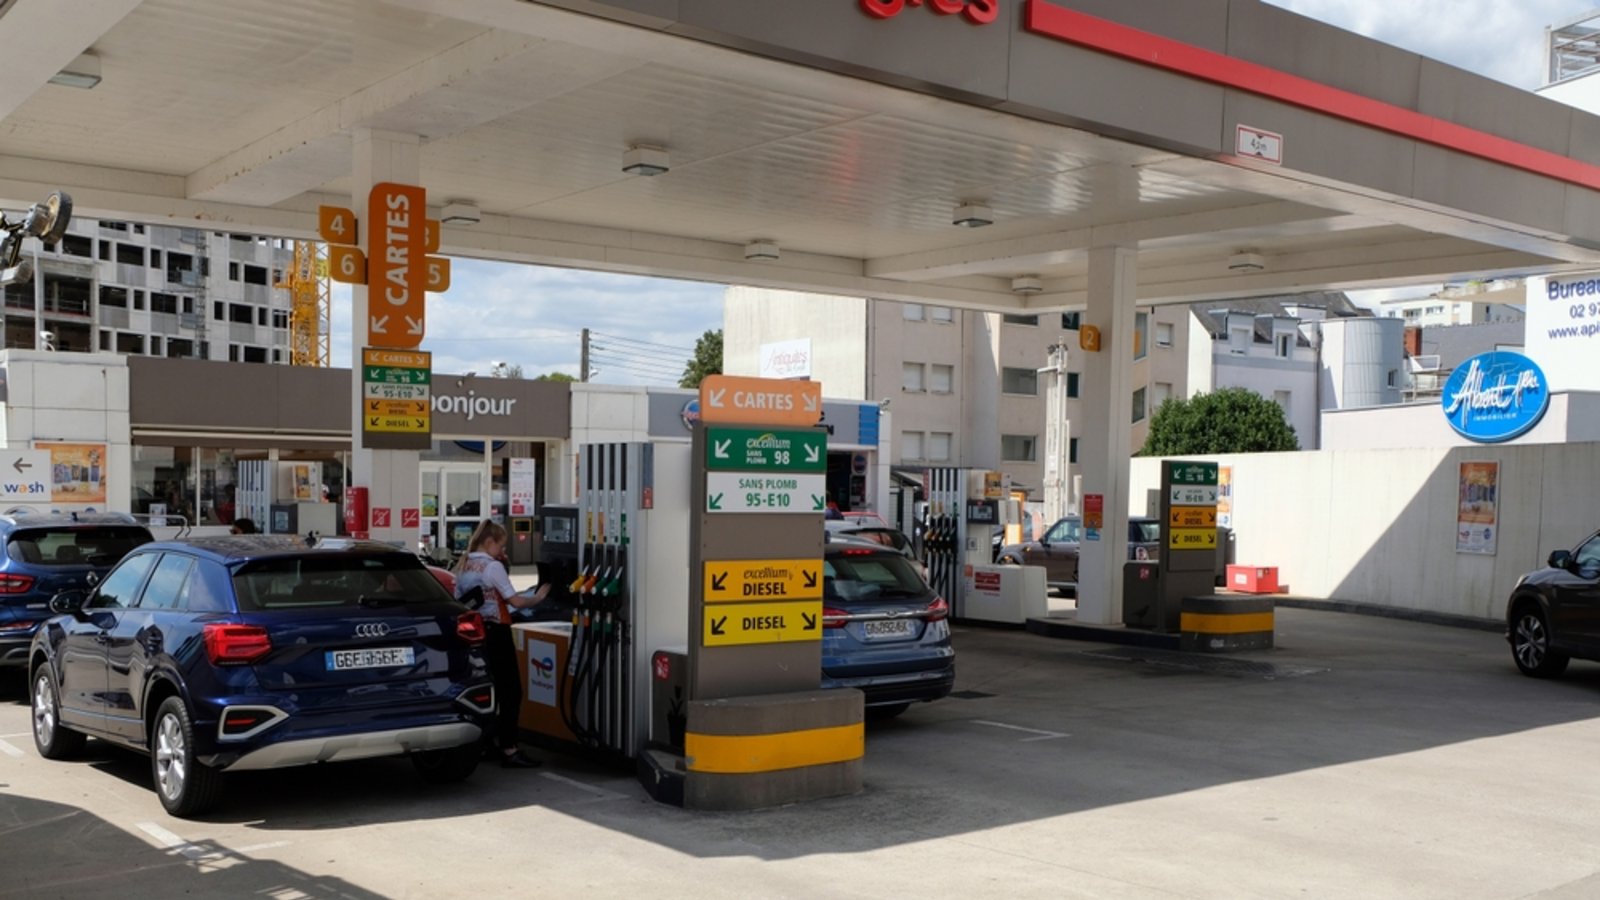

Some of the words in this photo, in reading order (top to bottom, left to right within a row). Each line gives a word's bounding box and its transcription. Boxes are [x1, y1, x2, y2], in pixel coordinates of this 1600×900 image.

[330, 214, 345, 236] 4
[386, 193, 410, 307] CARTES
[341, 253, 356, 276] 6
[428, 263, 441, 285] 5
[1570, 303, 1585, 319] 02
[1086, 329, 1095, 346] 2
[383, 354, 413, 363] CARTES
[384, 390, 413, 399] 95-E10
[733, 391, 794, 411] CARTES
[385, 419, 410, 428] DIESEL
[746, 449, 763, 458] SANS
[774, 450, 791, 465] 98
[4, 481, 45, 494] wash
[738, 478, 764, 490] SANS
[765, 479, 798, 490] PLOMB
[745, 492, 791, 508] 95-E10
[742, 581, 788, 597] DIESEL
[742, 615, 787, 631] DIESEL
